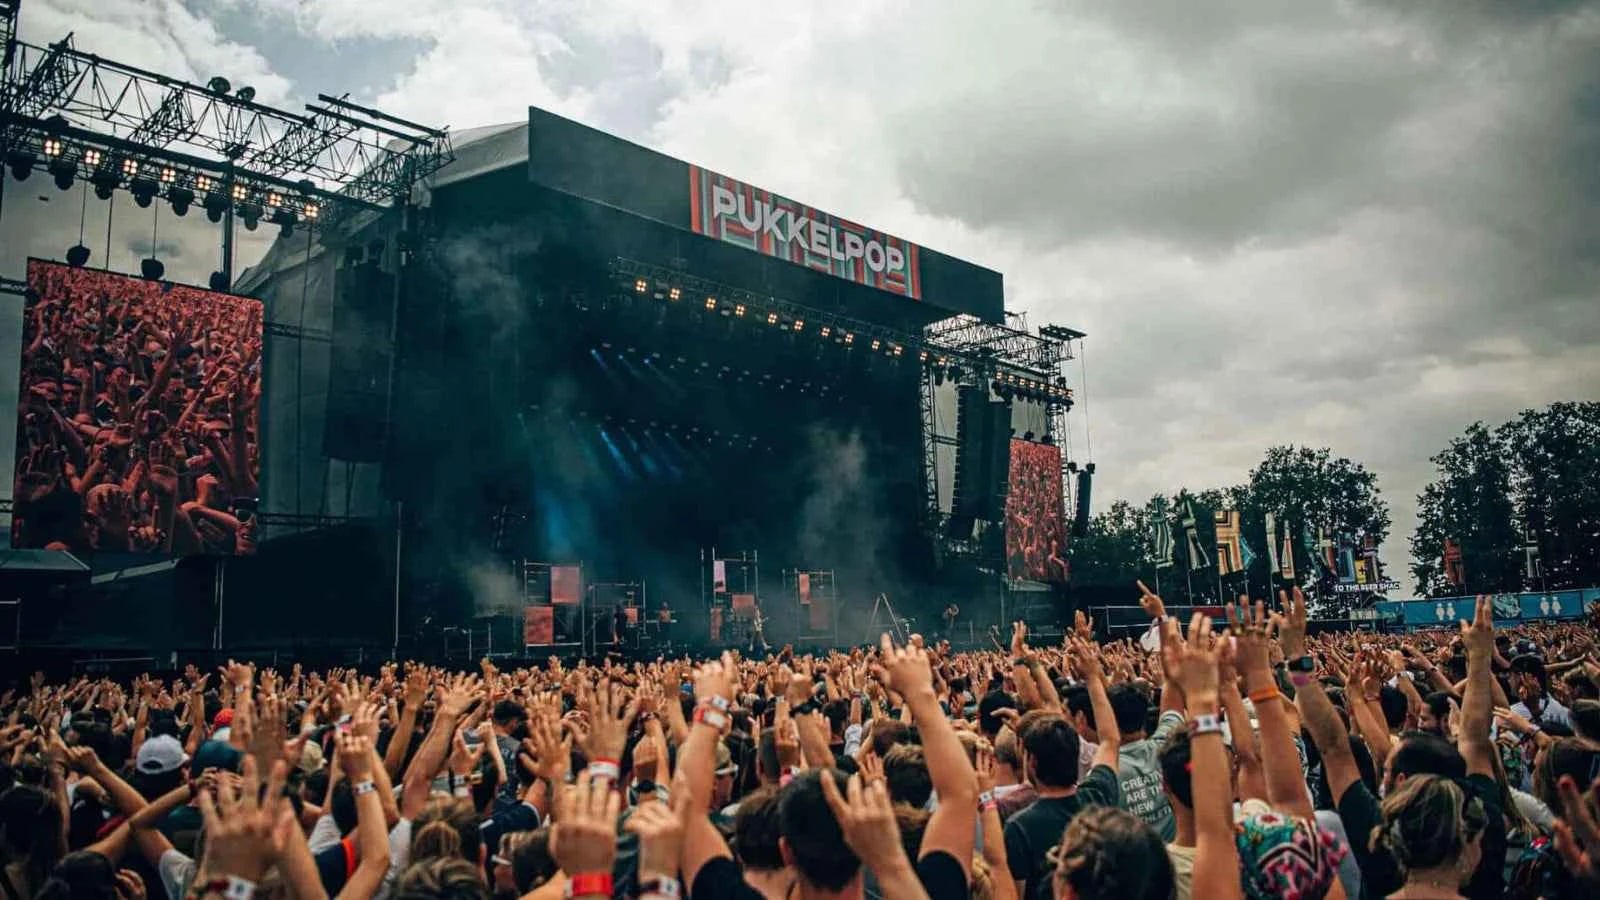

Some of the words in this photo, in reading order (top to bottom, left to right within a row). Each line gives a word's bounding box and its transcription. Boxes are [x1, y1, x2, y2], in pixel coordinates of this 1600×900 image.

[712, 184, 905, 274] PUKKELPOP
[1126, 788, 1148, 804] ARE
[1128, 801, 1154, 817] NEW
